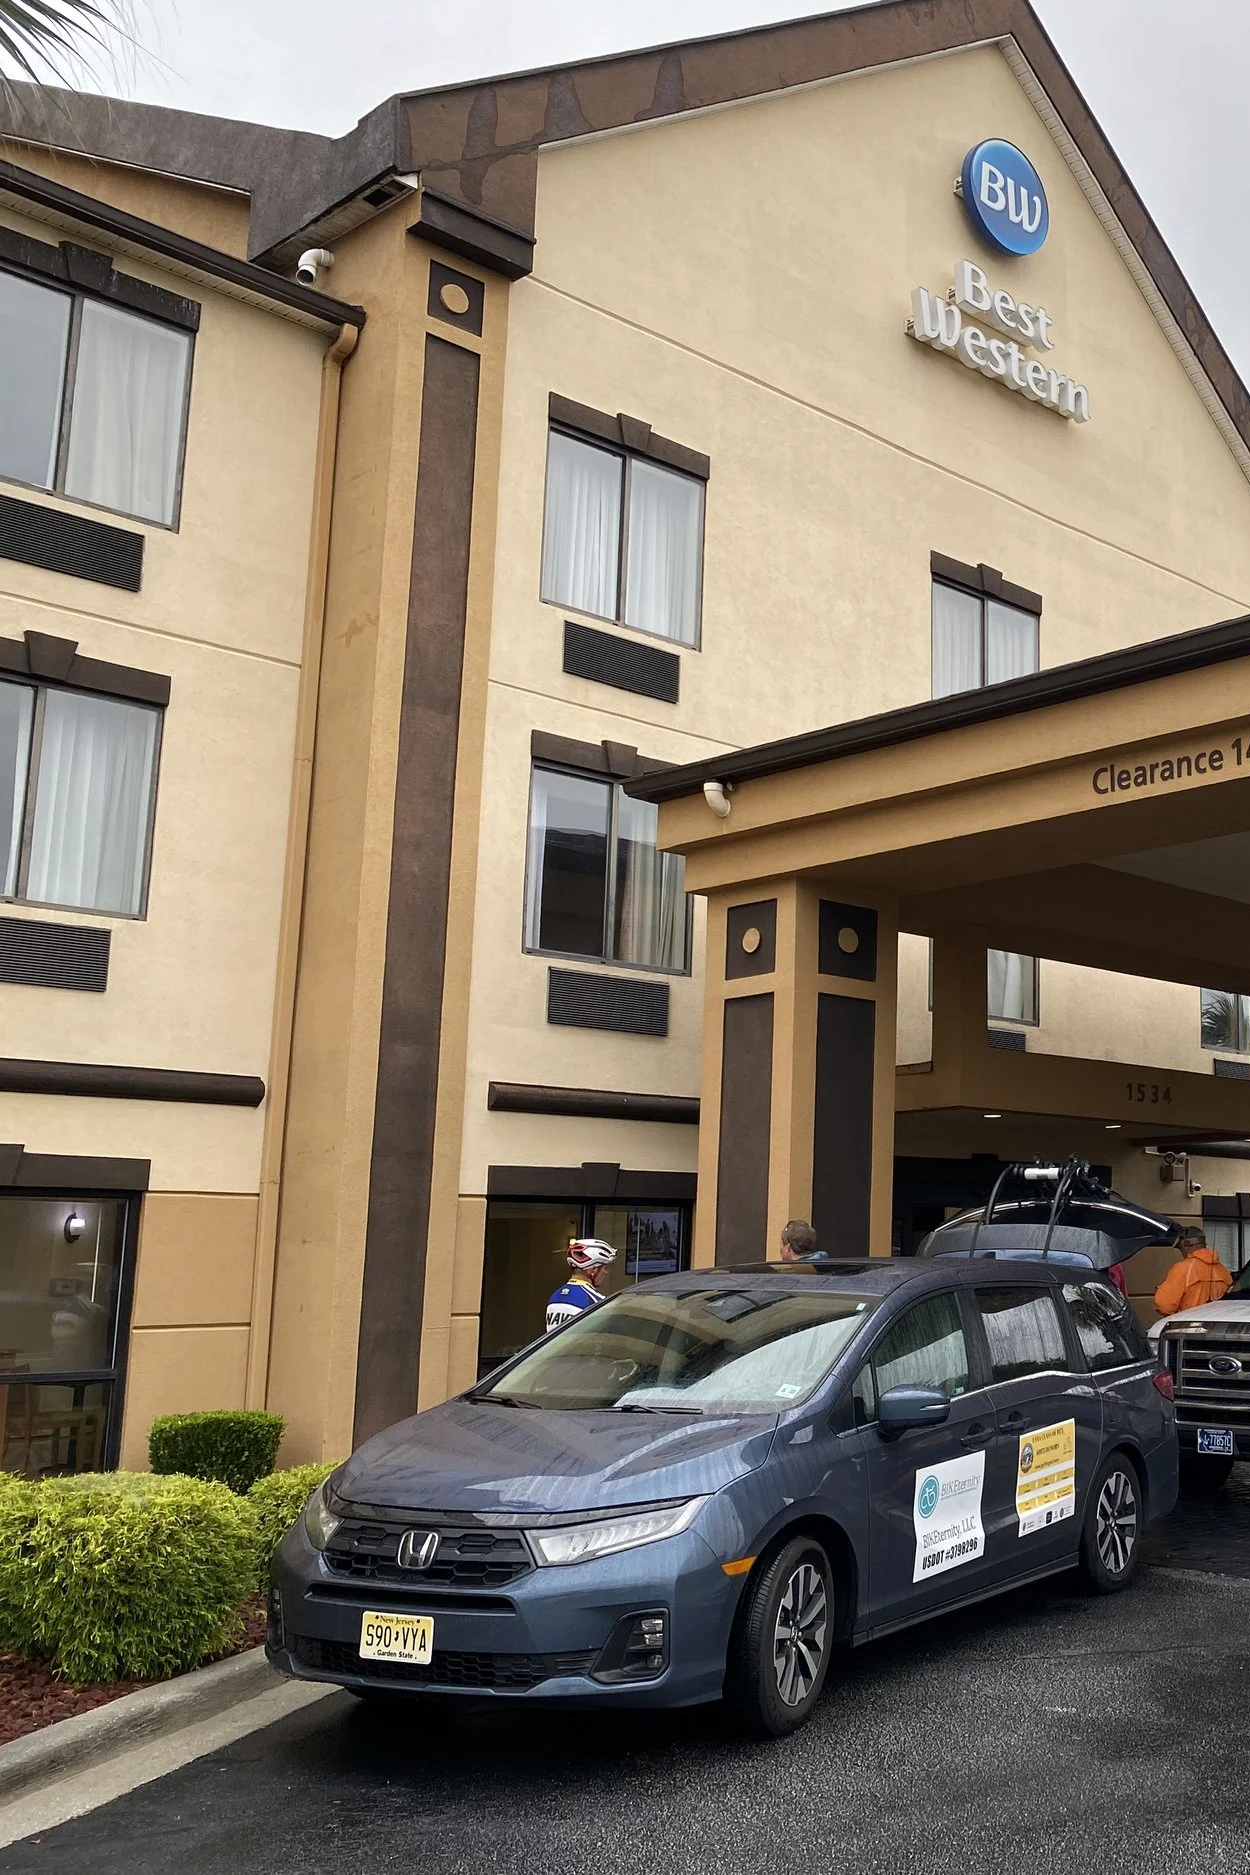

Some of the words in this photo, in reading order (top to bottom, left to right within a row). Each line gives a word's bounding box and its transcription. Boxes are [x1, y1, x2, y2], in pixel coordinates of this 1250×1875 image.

[980, 161, 1042, 234] BW
[956, 259, 1054, 352] Best
[911, 286, 1091, 424] Western
[1092, 749, 1224, 795] Clearance
[1126, 1082, 1172, 1105] 1534
[941, 1475, 980, 1496] BIKEternity
[962, 1516, 976, 1533] LLC
[922, 1550, 945, 1570] USDOT
[380, 1615, 394, 1624] New
[395, 1616, 415, 1626] Jersey
[402, 1626, 426, 1652] VYA
[377, 1649, 397, 1658] Garden
[398, 1651, 413, 1659] State
